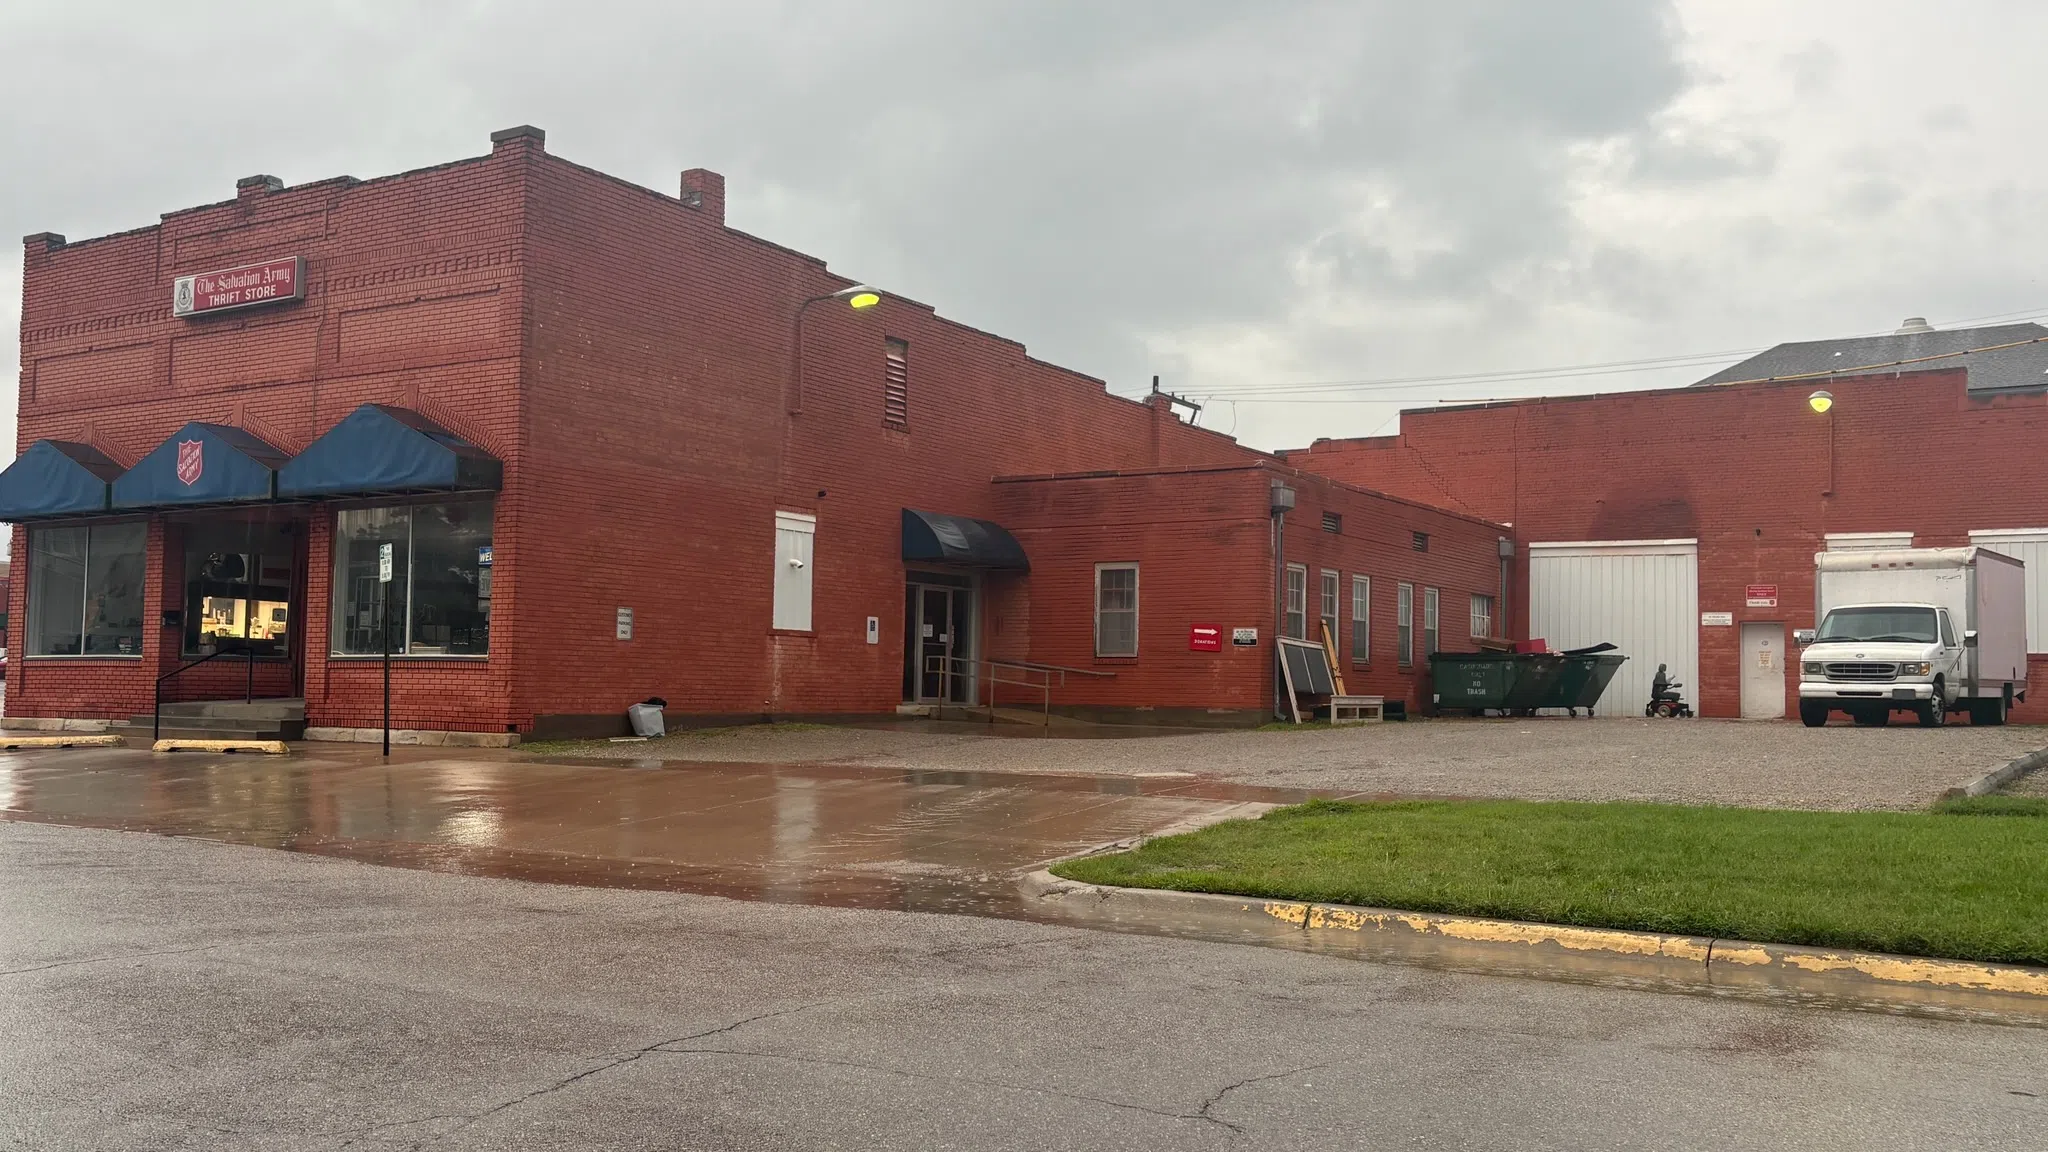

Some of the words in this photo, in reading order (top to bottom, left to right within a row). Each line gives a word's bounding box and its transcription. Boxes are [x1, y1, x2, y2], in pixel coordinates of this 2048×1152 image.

[197, 278, 215, 295] The
[217, 270, 260, 292] Salvation
[262, 266, 290, 284] Army
[209, 291, 240, 307] THRIFT
[245, 284, 276, 300] STORE
[178, 445, 200, 475] SALVATION
[185, 458, 199, 480] ARMY
